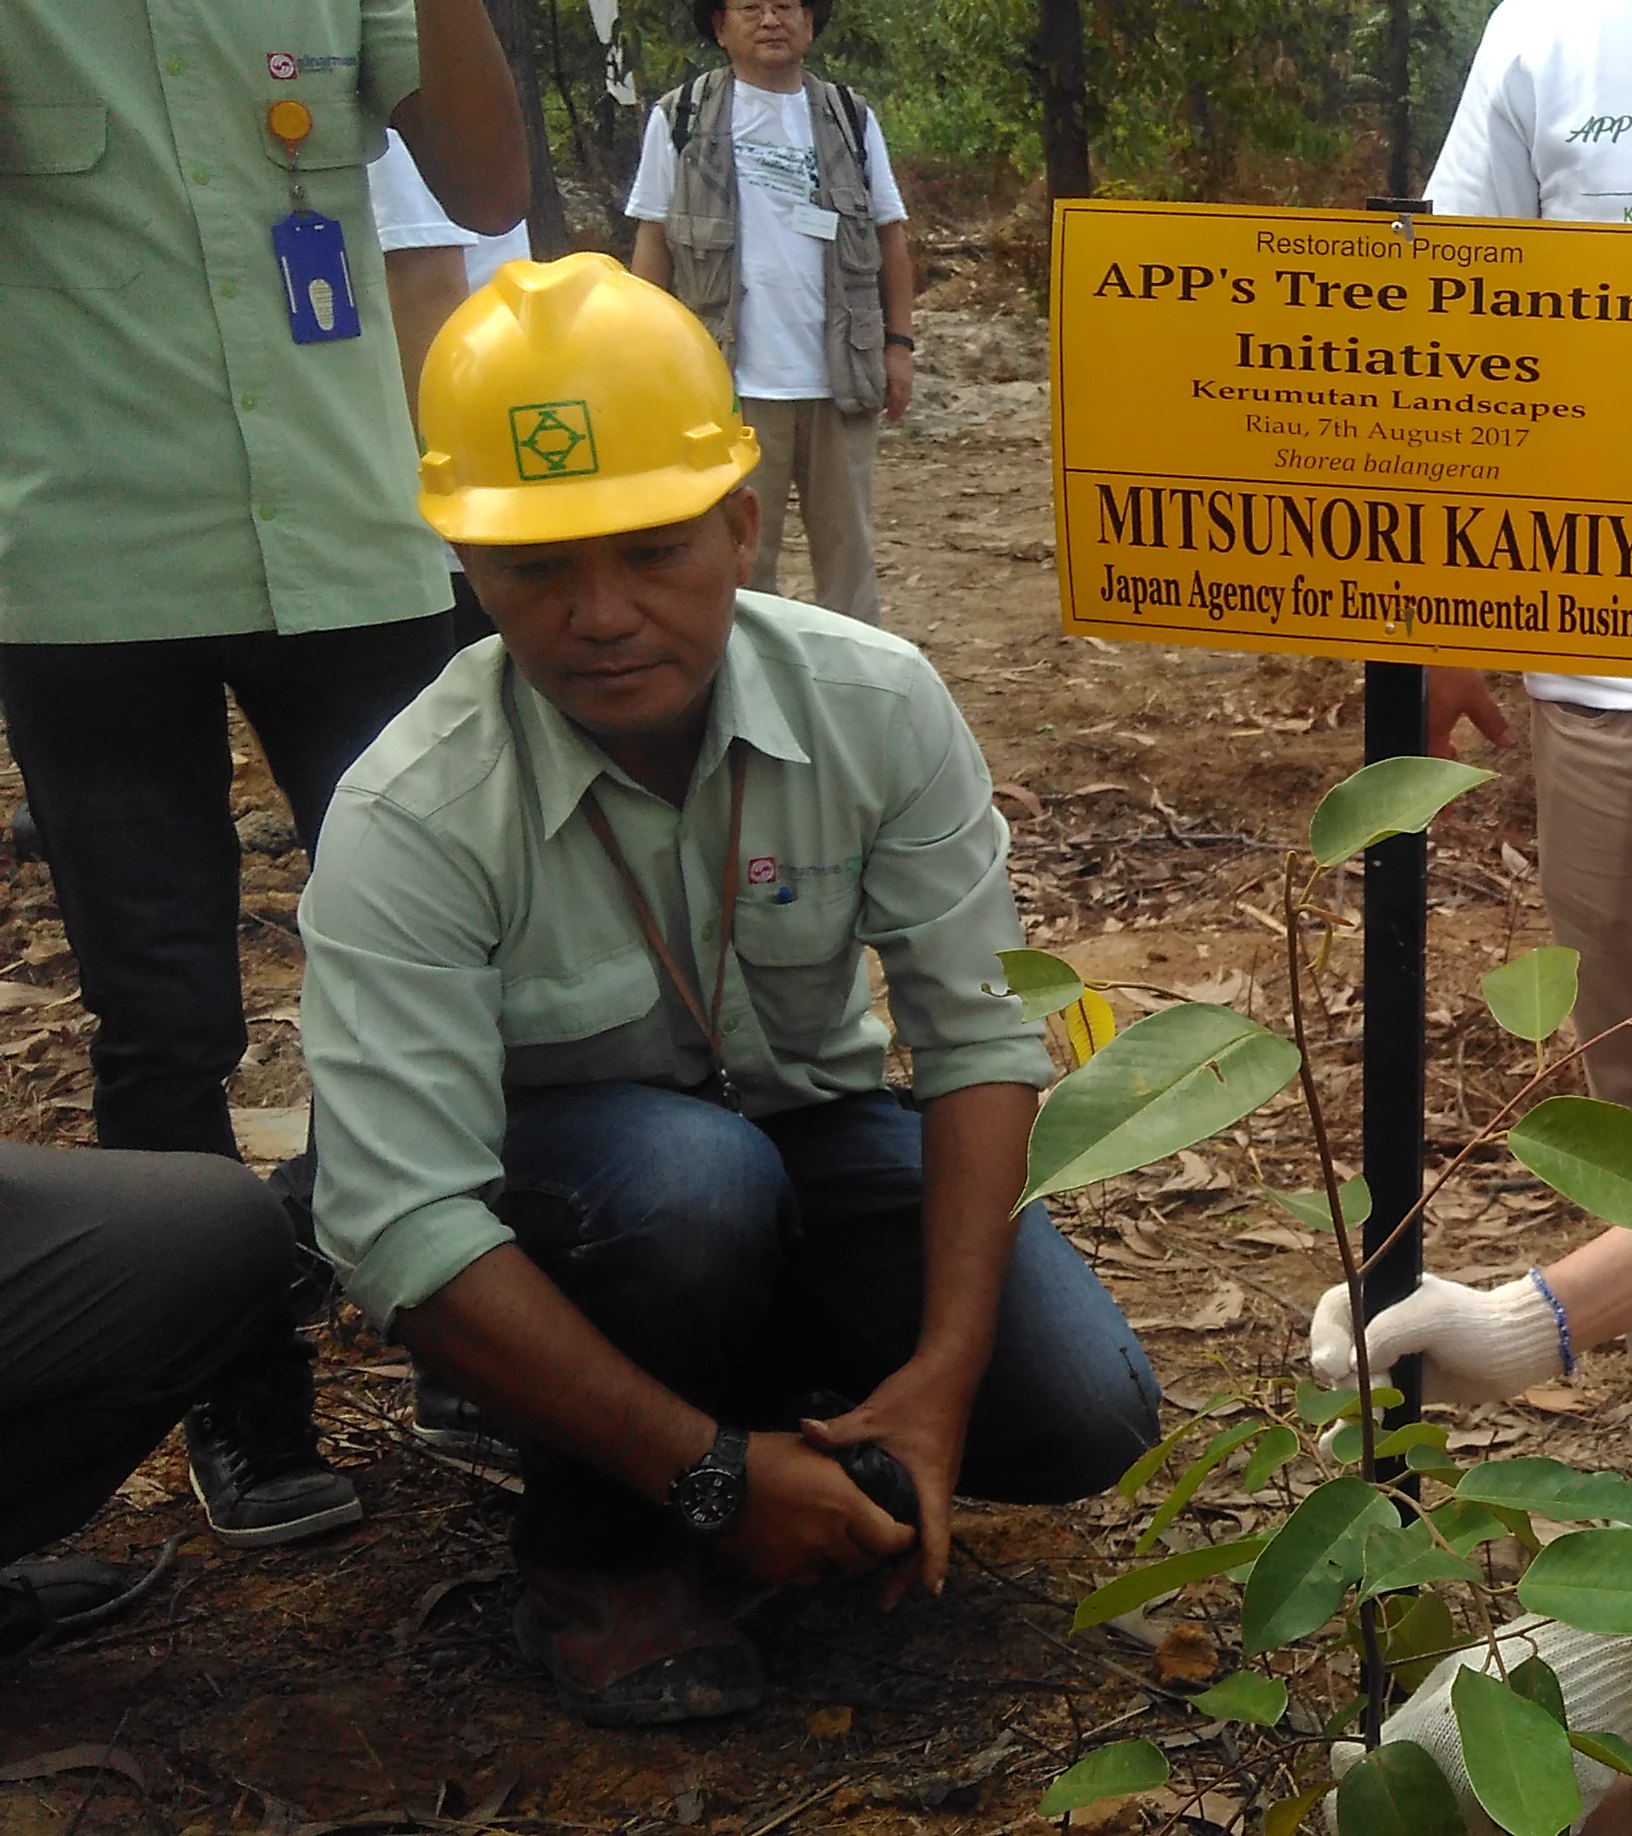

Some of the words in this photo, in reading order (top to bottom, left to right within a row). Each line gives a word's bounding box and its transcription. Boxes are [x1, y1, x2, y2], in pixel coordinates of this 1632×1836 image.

[1257, 231, 1402, 259] Restoration
[1412, 237, 1523, 267] Program
[1093, 262, 1256, 304] APP's
[1276, 270, 1408, 312] Tree
[1236, 333, 1540, 383] Initiatives
[1192, 380, 1378, 408] Kerumutan
[1391, 390, 1586, 422] Landscapes
[1246, 415, 1309, 438] Riau,
[1318, 418, 1357, 439] 7th
[1367, 421, 1462, 447] August
[1470, 426, 1530, 447] 2017
[1274, 449, 1355, 472] Shorea
[1363, 453, 1500, 482] balangeran
[1095, 484, 1425, 565] MITSUNORI
[1100, 564, 1183, 608] Japan
[1188, 570, 1286, 625] Agency
[1291, 574, 1334, 618] for
[1340, 580, 1550, 634] Environmental
